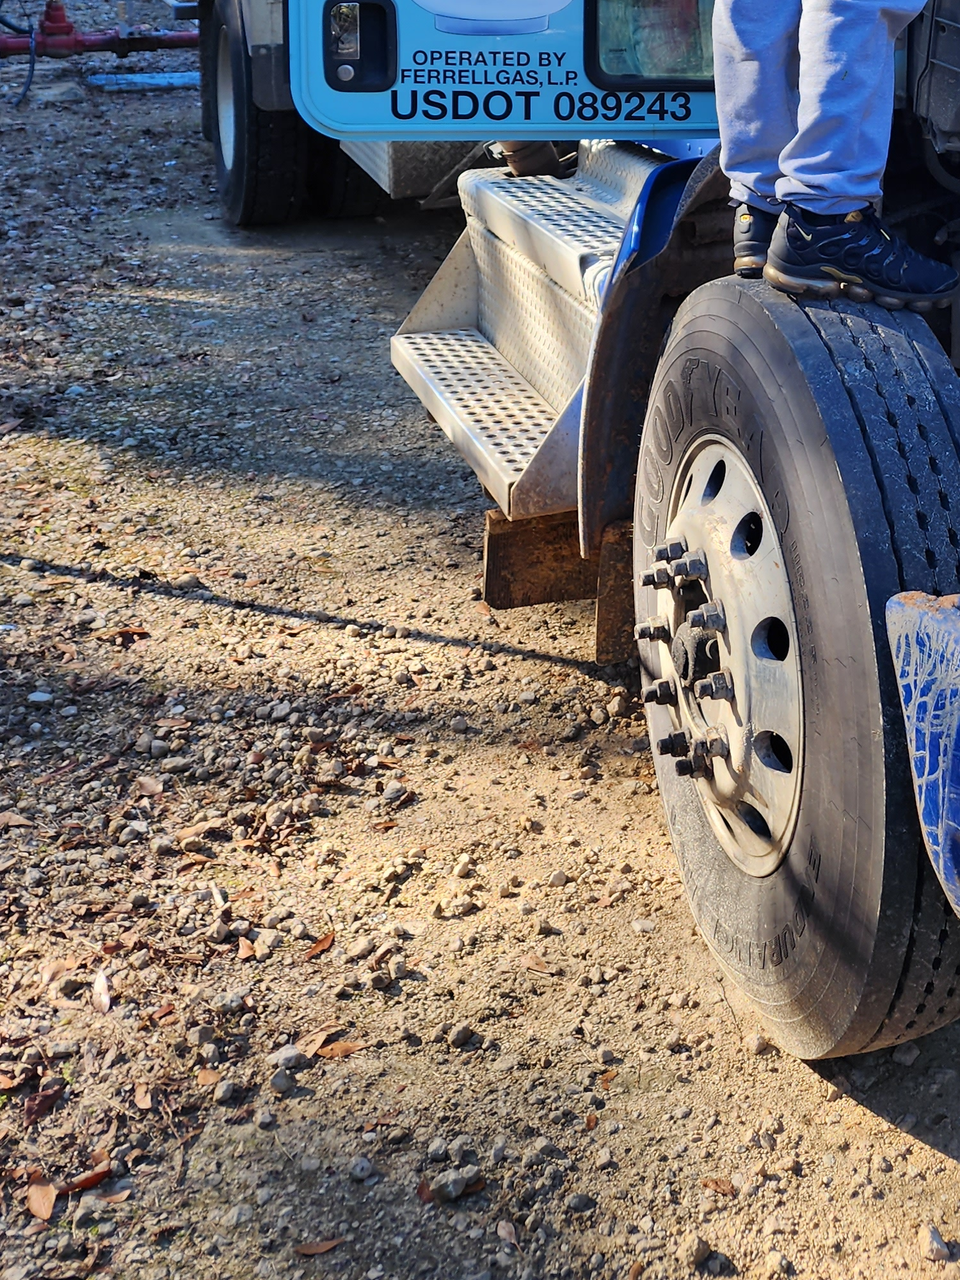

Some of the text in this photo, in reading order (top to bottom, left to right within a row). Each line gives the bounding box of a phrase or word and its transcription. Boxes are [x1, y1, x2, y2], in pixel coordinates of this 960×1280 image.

[412, 50, 567, 67] OPERATED BY
[400, 69, 578, 88] FERRELLGAS, L.P.
[390, 90, 692, 121] USDOT 089243
